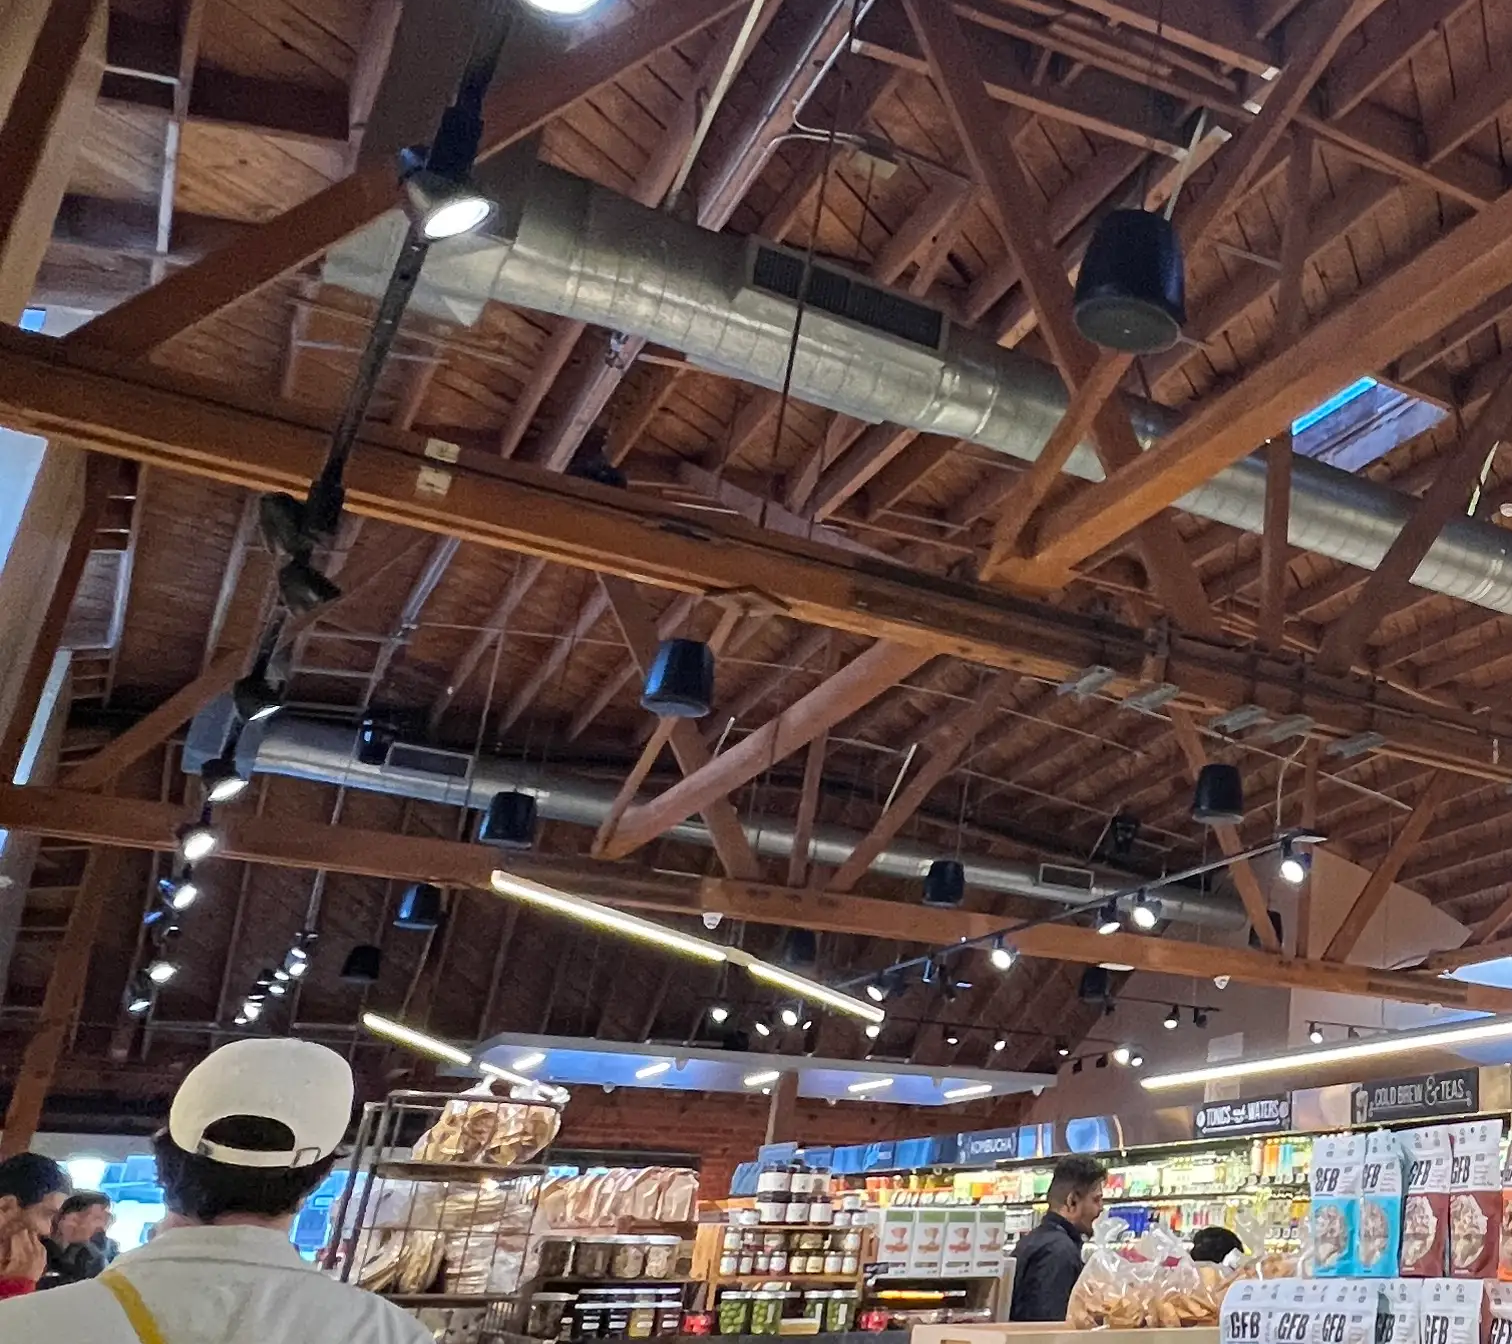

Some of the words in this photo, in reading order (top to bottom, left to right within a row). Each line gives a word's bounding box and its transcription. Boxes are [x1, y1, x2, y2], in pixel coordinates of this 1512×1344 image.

[1375, 1086, 1397, 1106] COLD
[1424, 1076, 1440, 1106] &
[1440, 1078, 1464, 1100] TEAS
[1450, 1155, 1471, 1184] GFB
[1229, 1311, 1261, 1339] GFB
[1277, 1312, 1310, 1342] GFB
[1321, 1312, 1347, 1343] GFB
